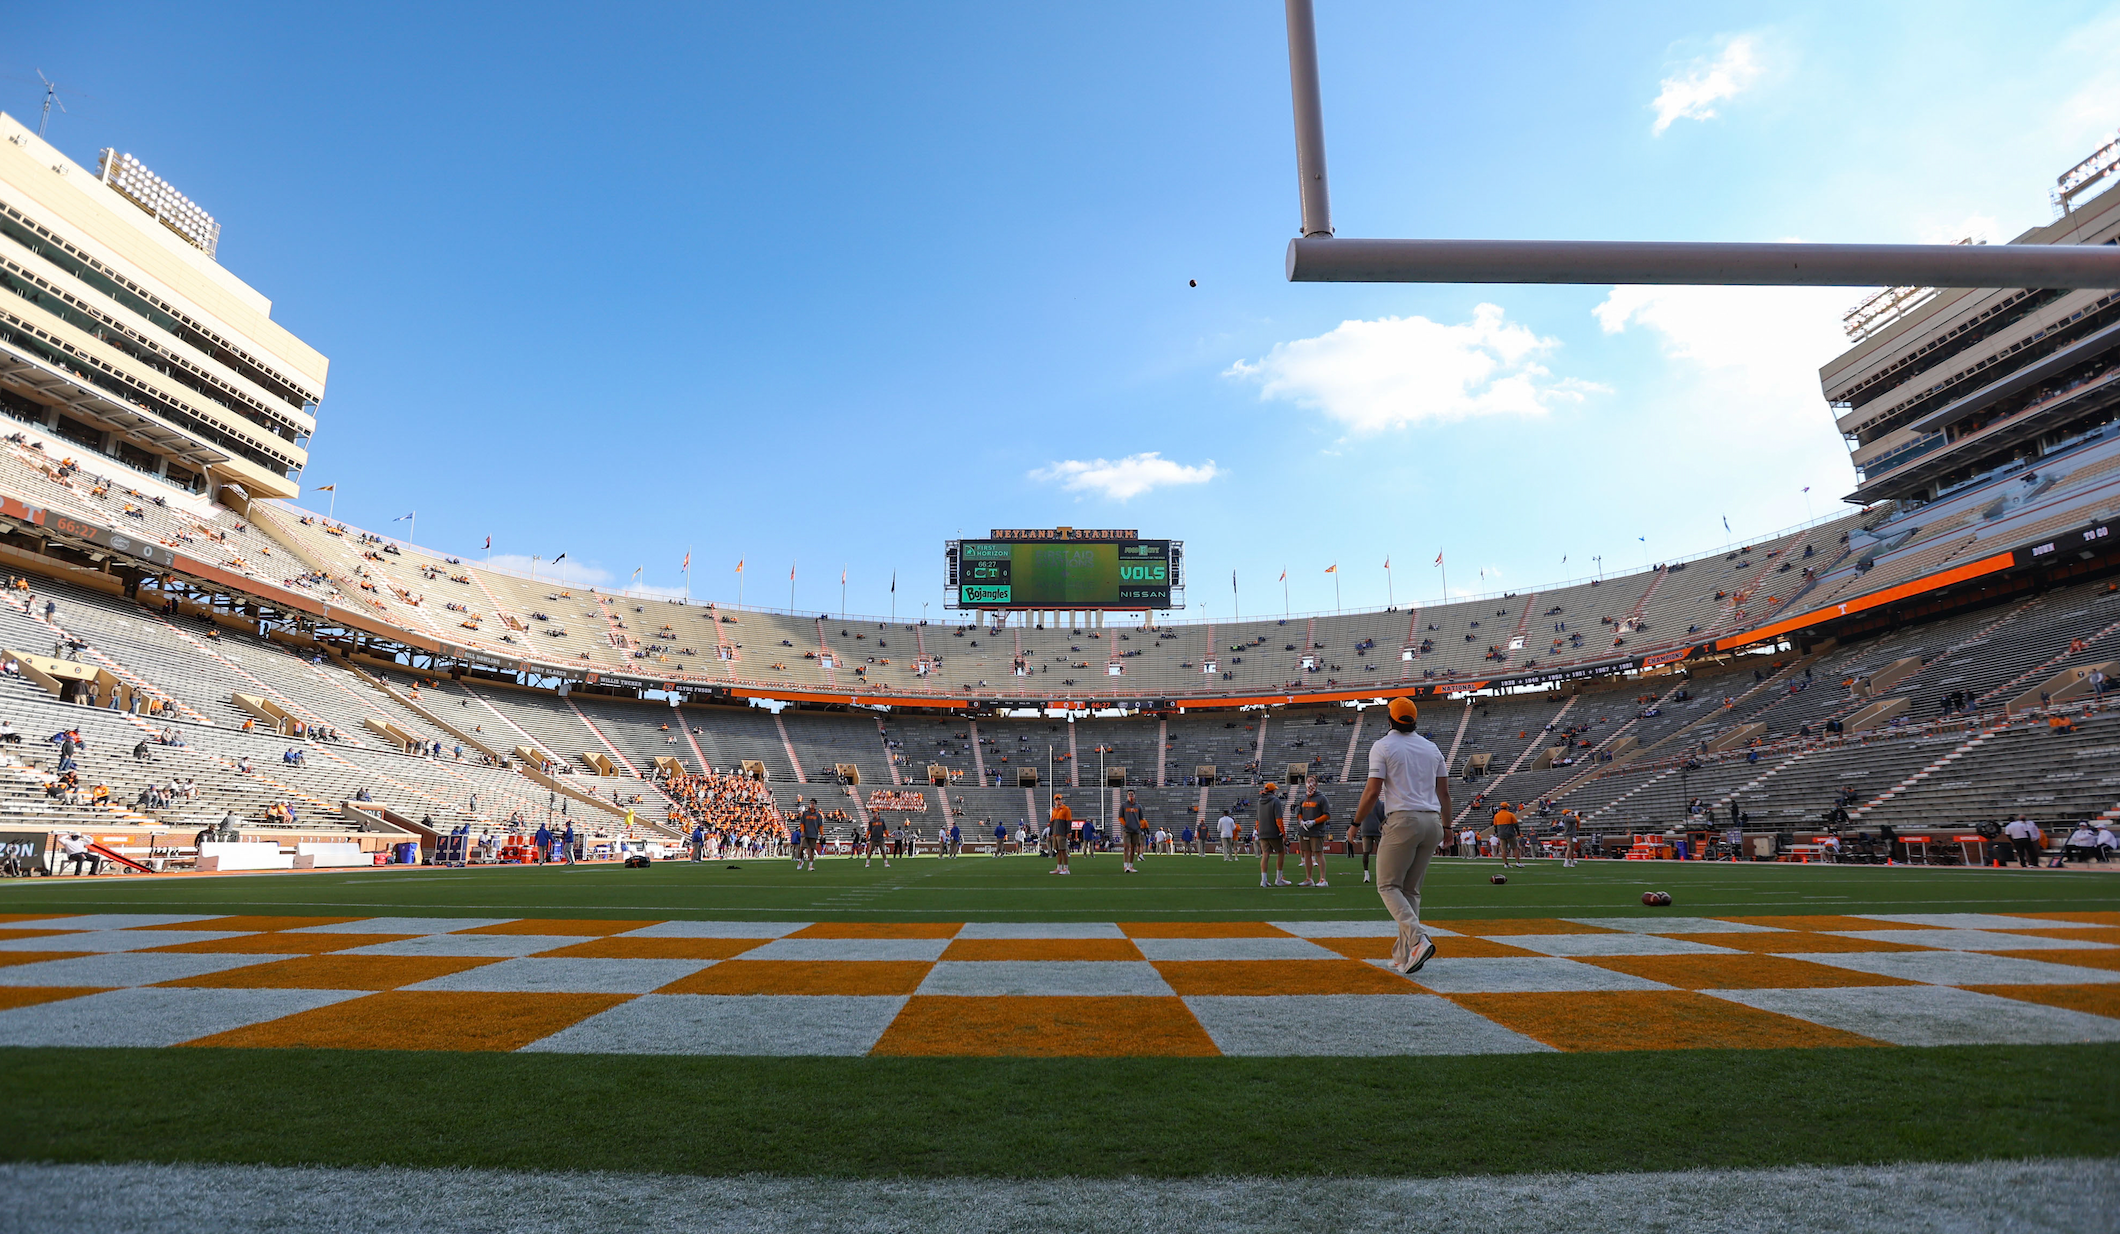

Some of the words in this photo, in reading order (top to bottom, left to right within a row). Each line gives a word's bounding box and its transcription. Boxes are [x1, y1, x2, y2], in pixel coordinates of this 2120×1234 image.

[57, 518, 98, 539] 66:27
[1057, 527, 1072, 540] T
[995, 530, 1055, 538] NEYLAND
[1075, 530, 1134, 538] STADIUM
[1036, 551, 1069, 559] FIRST
[1072, 551, 1094, 559] AID
[1121, 567, 1165, 579] VOLS
[965, 587, 1008, 601] Bojangles
[1647, 651, 1684, 665] CHAMPIONS
[600, 677, 620, 685] WILLIS
[1441, 683, 1476, 692] NATIONAL
